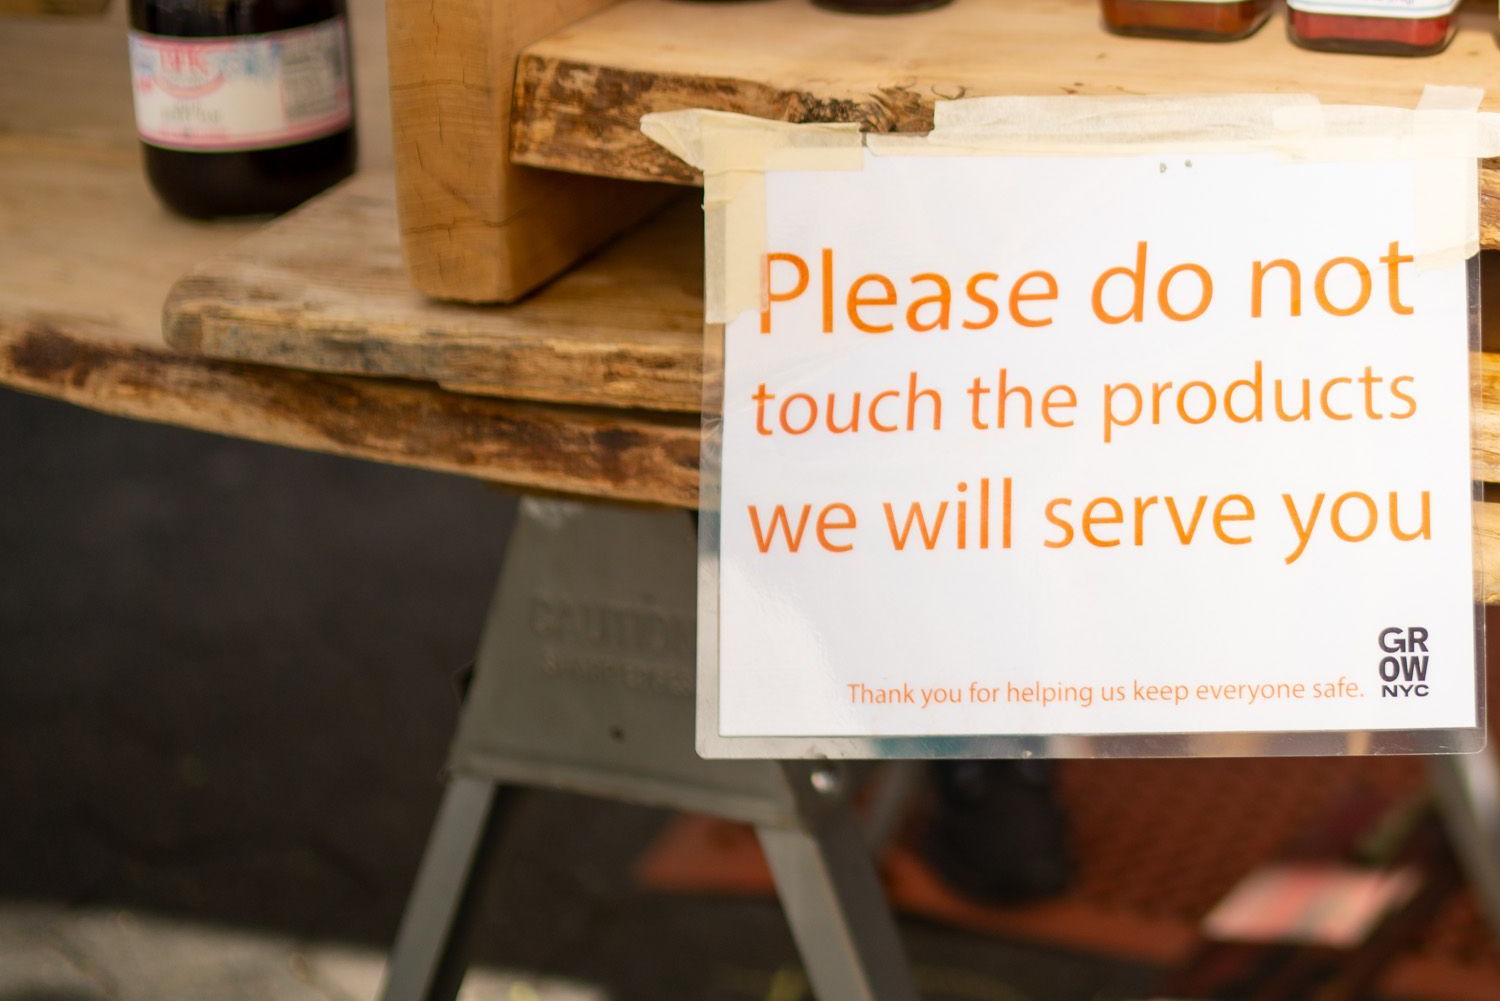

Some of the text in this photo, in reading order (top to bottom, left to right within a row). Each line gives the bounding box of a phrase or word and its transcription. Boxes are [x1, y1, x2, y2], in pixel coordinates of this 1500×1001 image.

[755, 241, 1416, 336] Please do not
[752, 360, 1418, 444] touch the products
[748, 477, 1433, 567] we will serve you
[1378, 627, 1429, 653] GR
[1378, 655, 1429, 682] OW
[847, 677, 1366, 708] Thank you for helping us keep everyone safe.
[1381, 684, 1430, 698] NYC
